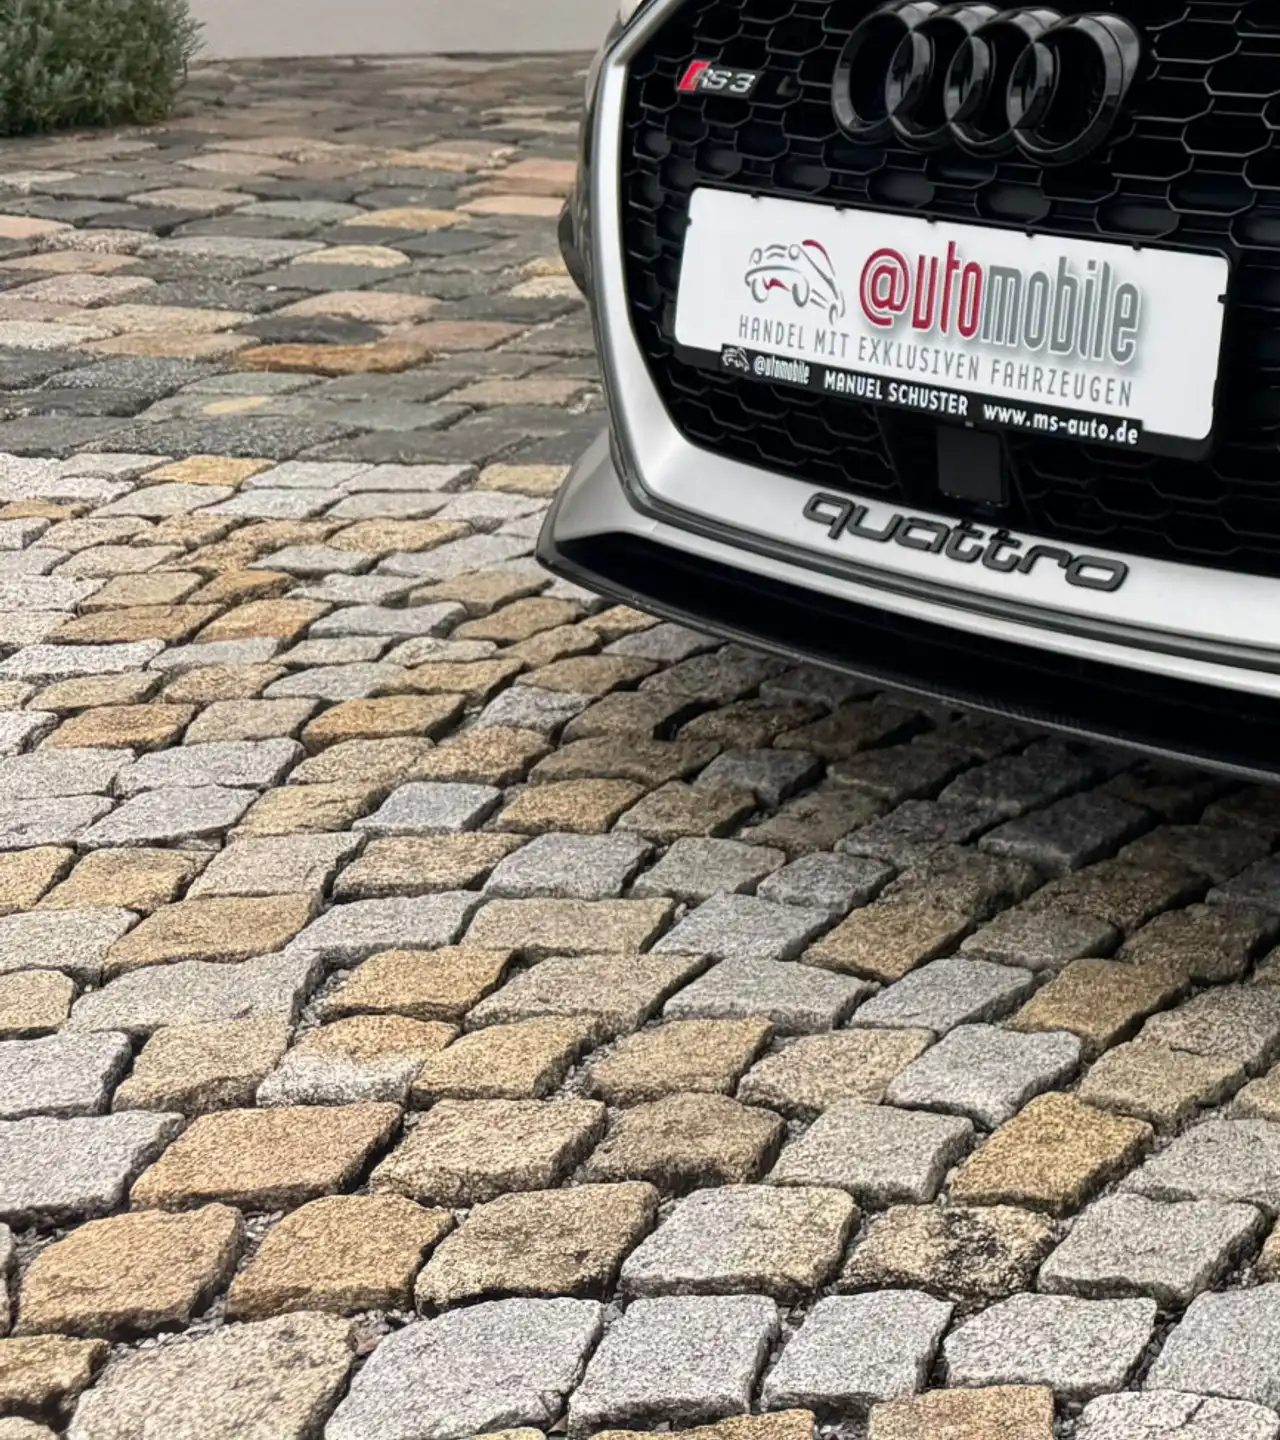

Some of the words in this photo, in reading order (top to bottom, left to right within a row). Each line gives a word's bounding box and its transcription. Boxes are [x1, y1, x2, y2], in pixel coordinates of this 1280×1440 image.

[858, 240, 1140, 362] @utomobile
[738, 313, 805, 350] HANDEL
[813, 327, 850, 358] MIT
[857, 335, 980, 382] EXKLUSIVEN
[990, 358, 1133, 408] FAHRZEUGEN
[823, 369, 884, 401] MANUEL
[887, 382, 969, 417] SCHUSTER
[983, 403, 1139, 445] www.ms-auto.de
[802, 491, 1131, 593] quattro
